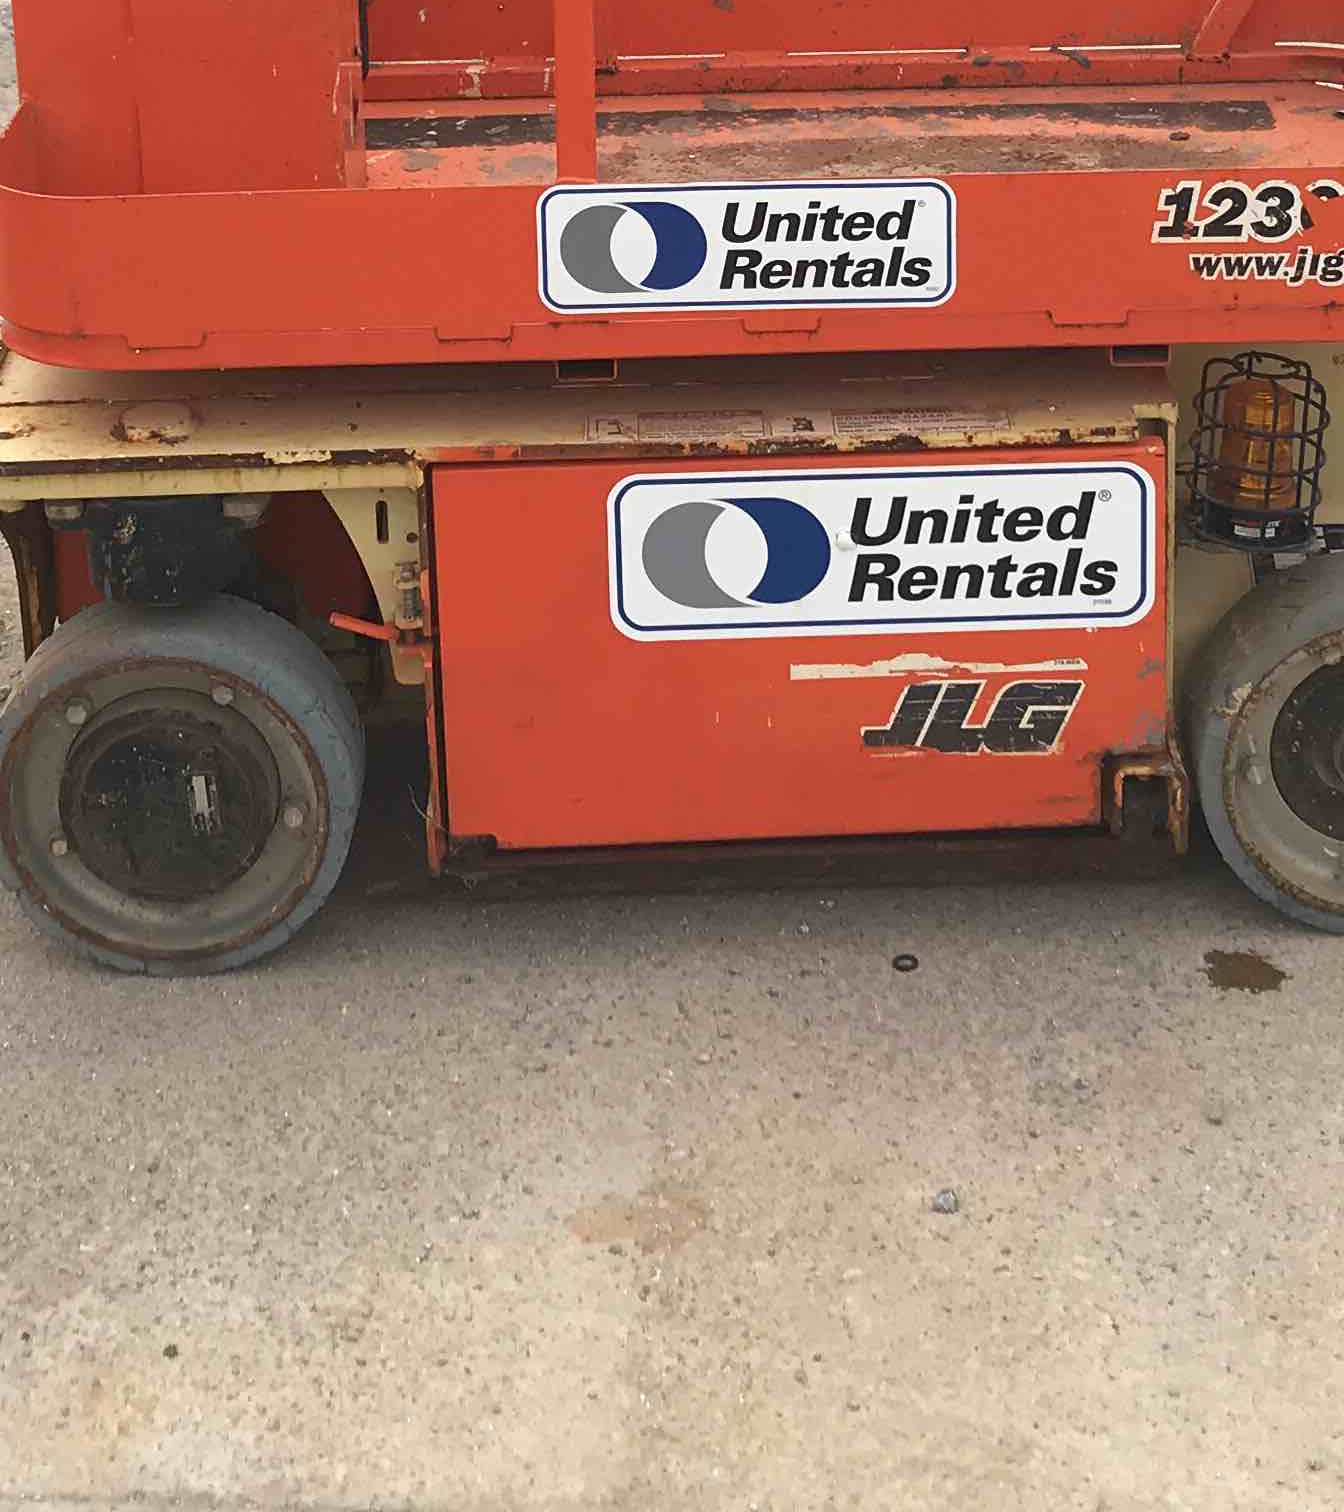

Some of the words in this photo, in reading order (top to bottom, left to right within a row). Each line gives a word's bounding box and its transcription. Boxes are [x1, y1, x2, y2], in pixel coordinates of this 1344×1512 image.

[721, 199, 917, 244] United
[719, 246, 933, 290] Rentals
[849, 491, 1097, 547] United
[847, 548, 1119, 603] Rentals
[860, 681, 1087, 755] JLG
